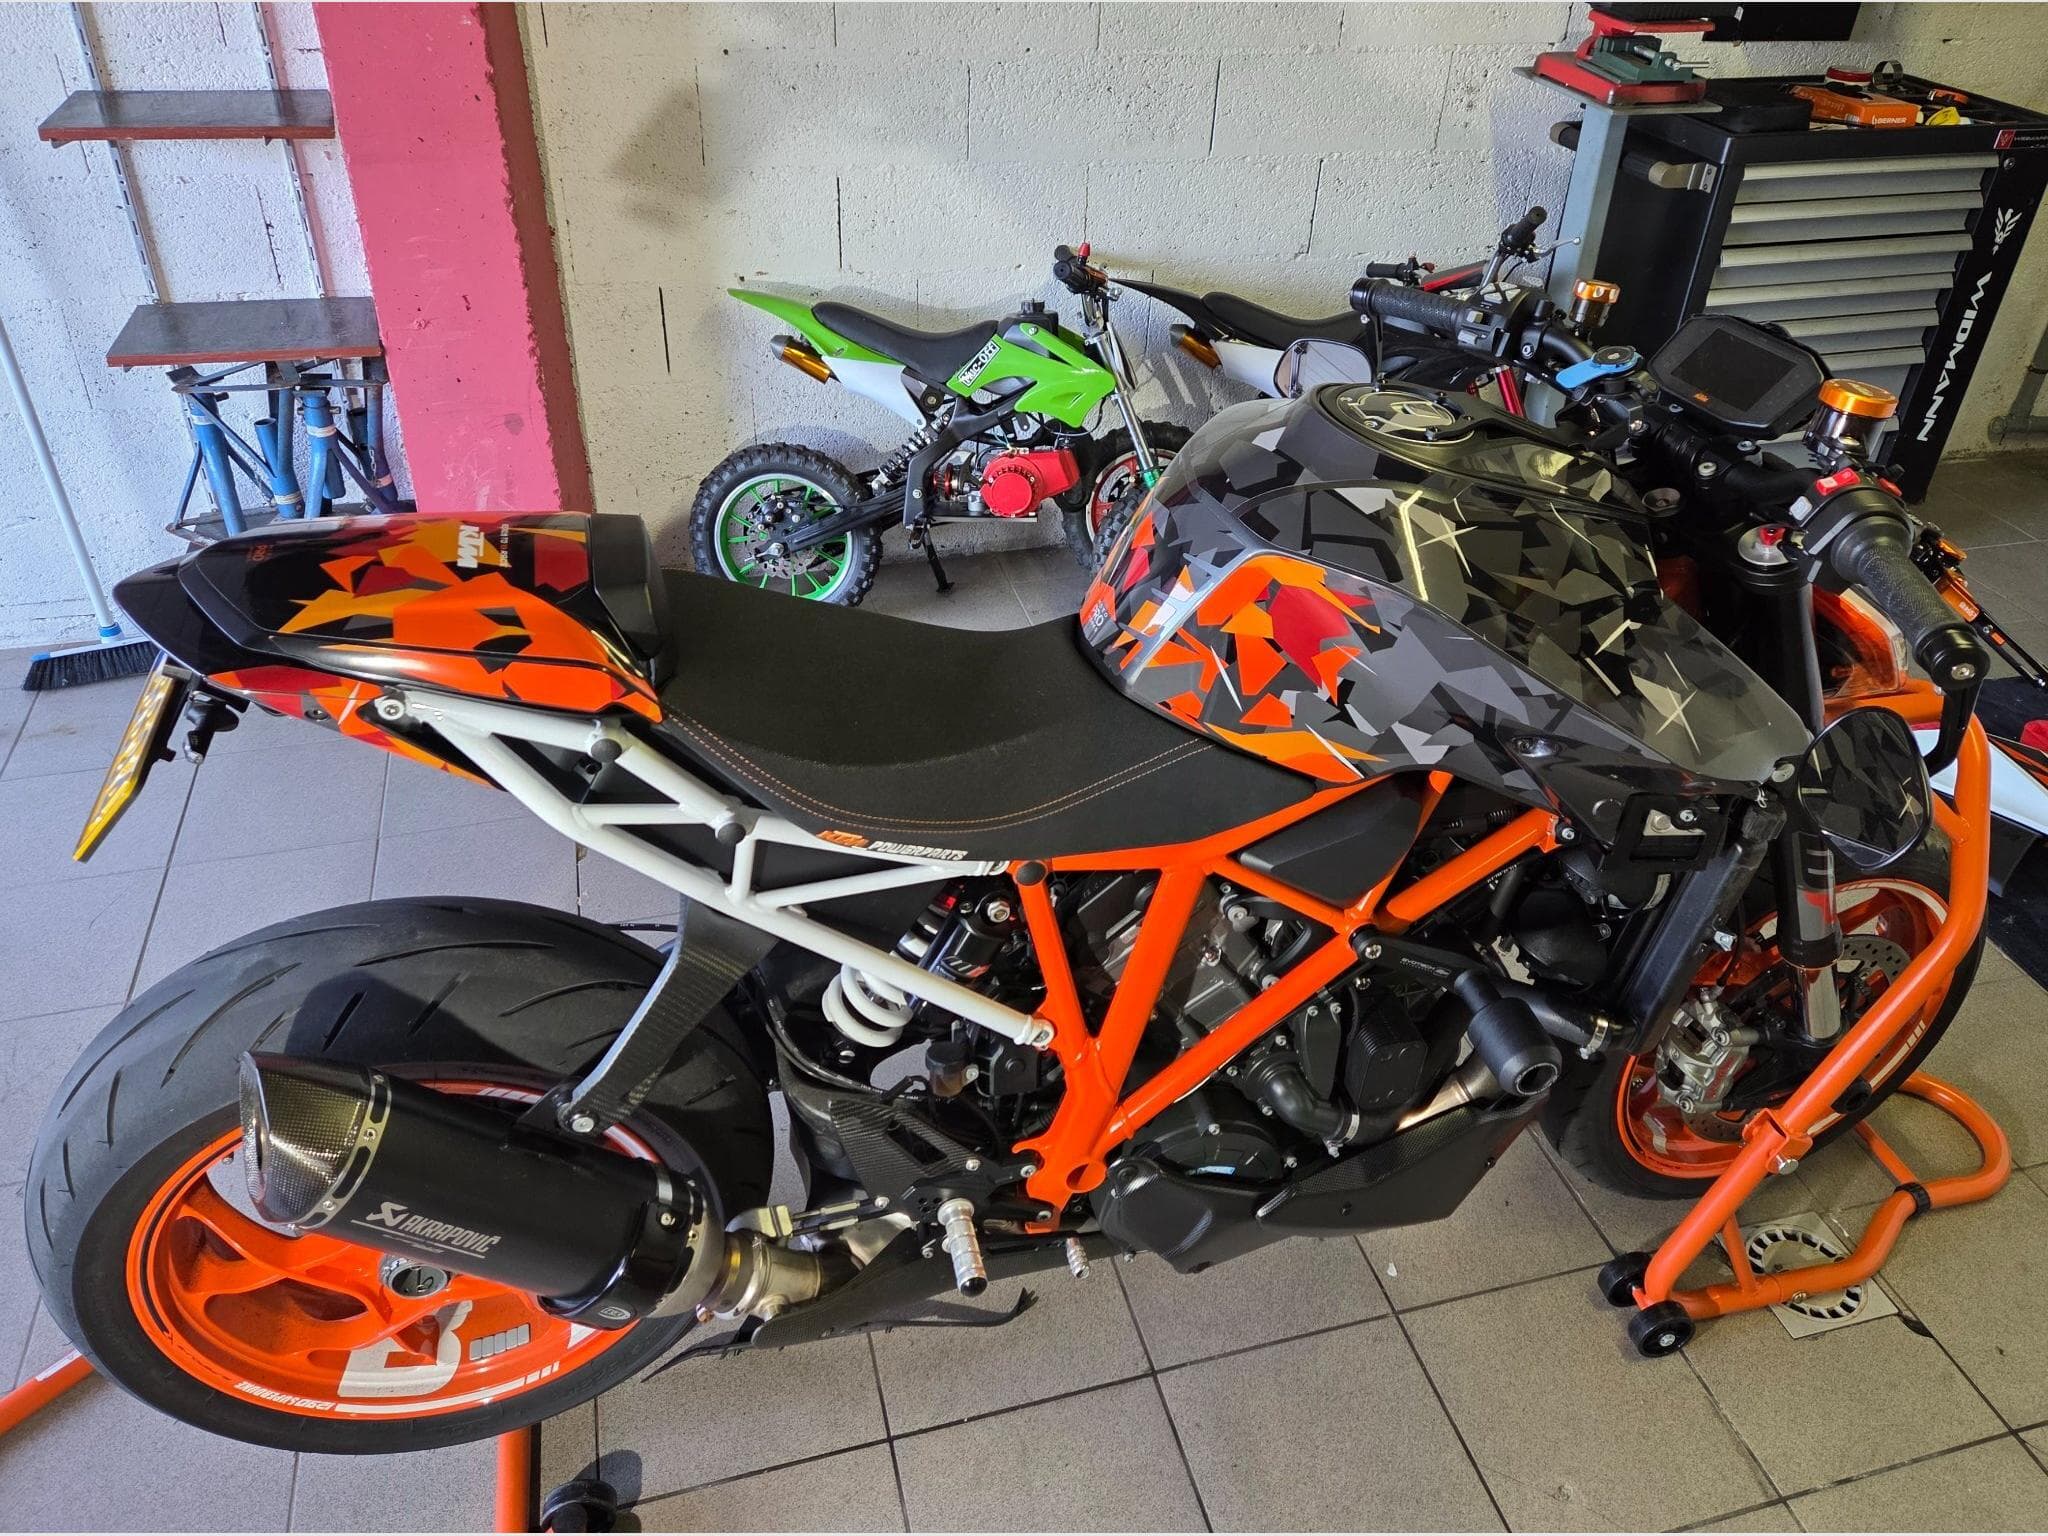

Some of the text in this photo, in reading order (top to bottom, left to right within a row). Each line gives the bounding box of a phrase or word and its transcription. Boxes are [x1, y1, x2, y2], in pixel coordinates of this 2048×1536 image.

[1876, 116, 1907, 125] BERNER
[1916, 271, 1993, 442] WIDMANN
[456, 524, 485, 569] KTM
[867, 840, 969, 861] POWERPARTS
[294, 1397, 337, 1411] 1290
